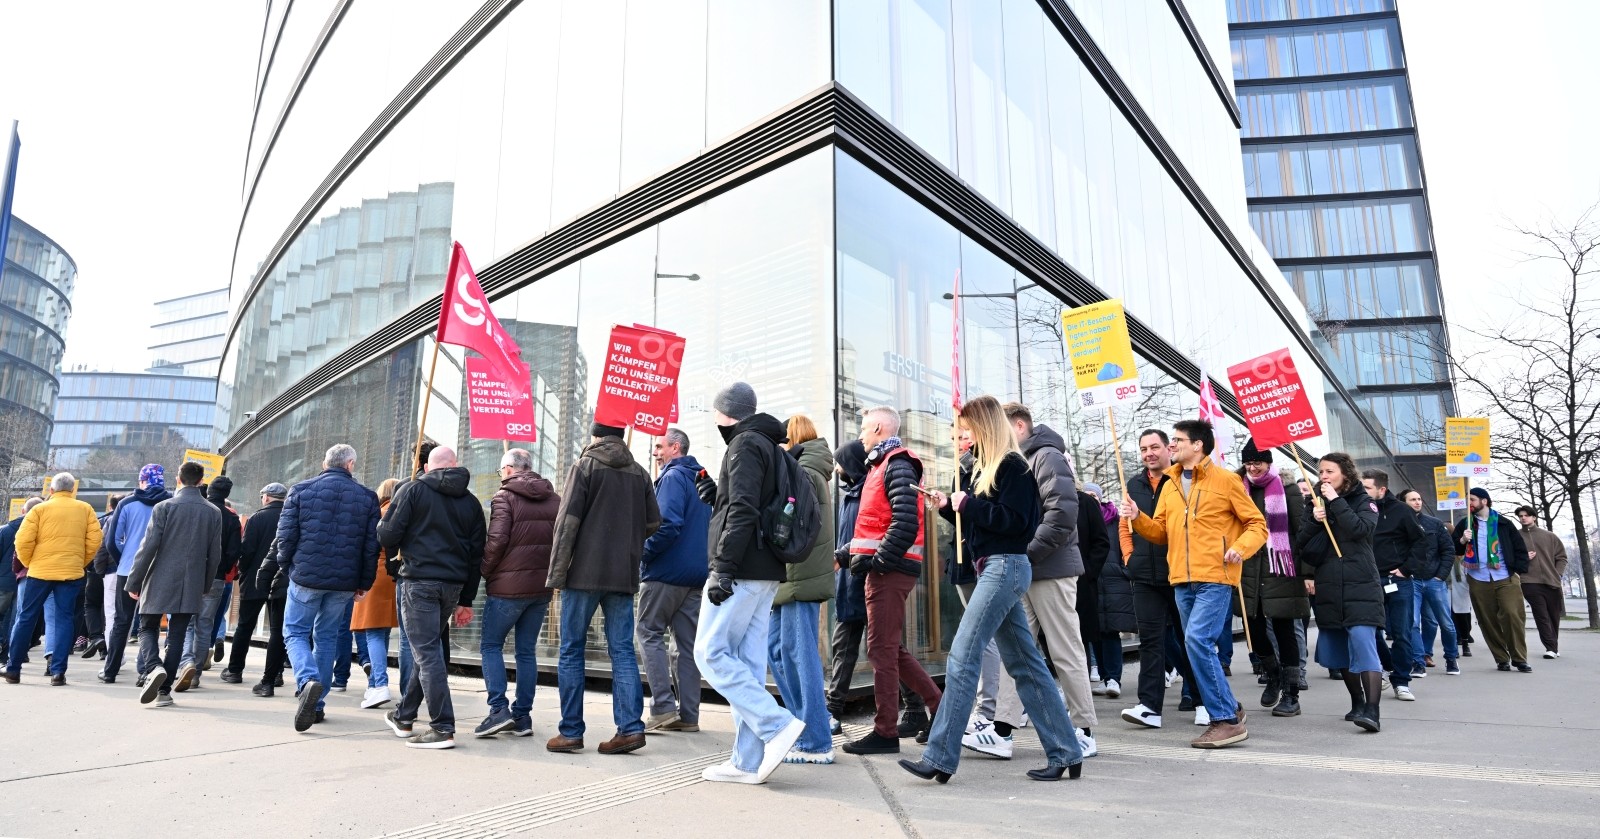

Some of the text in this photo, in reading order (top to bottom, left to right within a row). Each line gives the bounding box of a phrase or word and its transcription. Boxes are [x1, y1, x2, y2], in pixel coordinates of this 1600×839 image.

[1089, 325, 1111, 335] haben
[613, 342, 632, 354] WIR
[610, 353, 657, 371] KÄMPFEN
[889, 352, 926, 382] ERSTE
[470, 371, 487, 379] WIR
[608, 363, 674, 386] FÜR UNSEREN
[1234, 377, 1252, 388] WIR
[471, 380, 508, 389] KÄMPFE
[606, 374, 662, 393] KOLLEKTIV-
[1238, 379, 1280, 397] KÄMPFEN
[472, 388, 489, 396] FÜR
[604, 385, 650, 403] VERTRAG!
[1115, 384, 1137, 400] gpa
[1241, 383, 1301, 406] FÜR UNSEREN
[472, 398, 521, 406] KOLLEKTI-
[473, 405, 515, 415] VERTRAG!
[1245, 396, 1294, 415] KOLLEKTIV-
[635, 411, 665, 427] gpa
[1249, 407, 1291, 424] VERTRAG!
[506, 422, 532, 435] gpa
[1287, 418, 1314, 437] gpa
[1473, 466, 1488, 474] gpa
